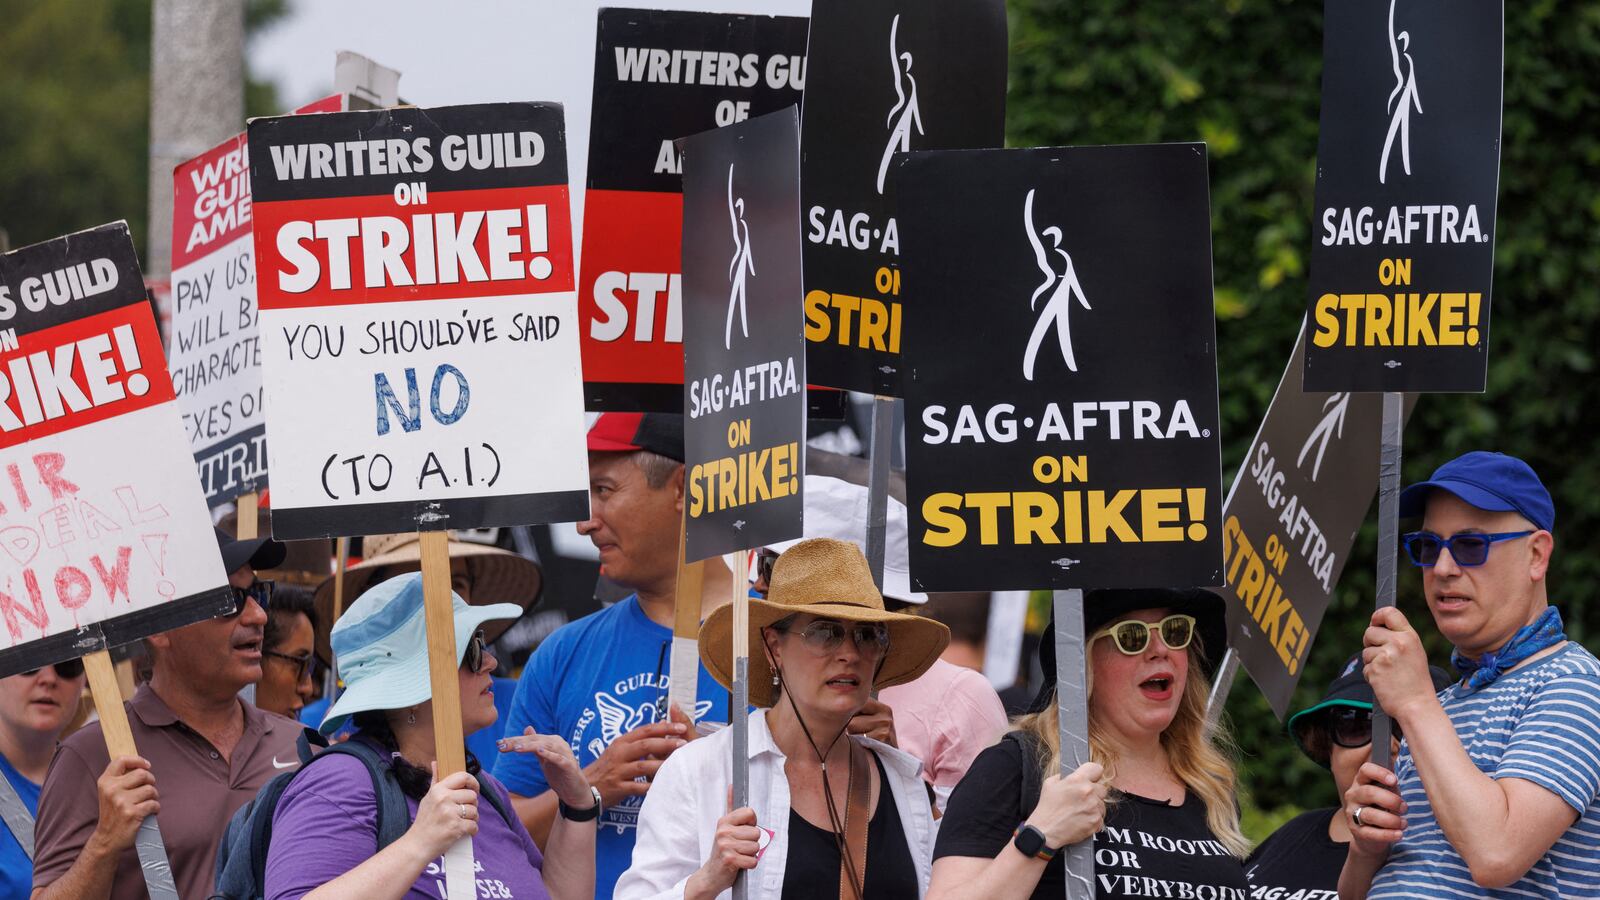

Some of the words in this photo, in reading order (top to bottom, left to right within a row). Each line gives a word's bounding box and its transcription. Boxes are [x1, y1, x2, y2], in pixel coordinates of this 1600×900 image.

[614, 46, 760, 89] WRITERS
[715, 99, 752, 128] OF
[269, 137, 434, 181] WRITERS
[440, 131, 546, 172] GUILD
[394, 181, 428, 206] ON
[276, 204, 554, 294] STRIKE!
[1378, 258, 1412, 287] ON
[20, 257, 120, 313] GUILD
[177, 269, 215, 314] PAY
[0, 327, 20, 353] N
[178, 310, 230, 356] WILL
[239, 296, 259, 330] B
[283, 323, 345, 361] YOU
[360, 309, 499, 355] SHOULD'VE
[508, 312, 561, 342] SAID
[1312, 292, 1482, 348] STRIKE!
[374, 363, 471, 437] NO
[727, 418, 751, 449] ON
[321, 453, 393, 500] (TO
[418, 443, 501, 490] A.I.)
[689, 441, 799, 519] STRIKE!
[1032, 455, 1088, 484] ON
[0, 485, 170, 566] DEAL
[921, 487, 1208, 548] STRIKE!
[1265, 533, 1289, 577] ON
[1223, 514, 1310, 678] STRIKE!
[614, 671, 670, 696] GUILD
[1095, 848, 1142, 869] OR
